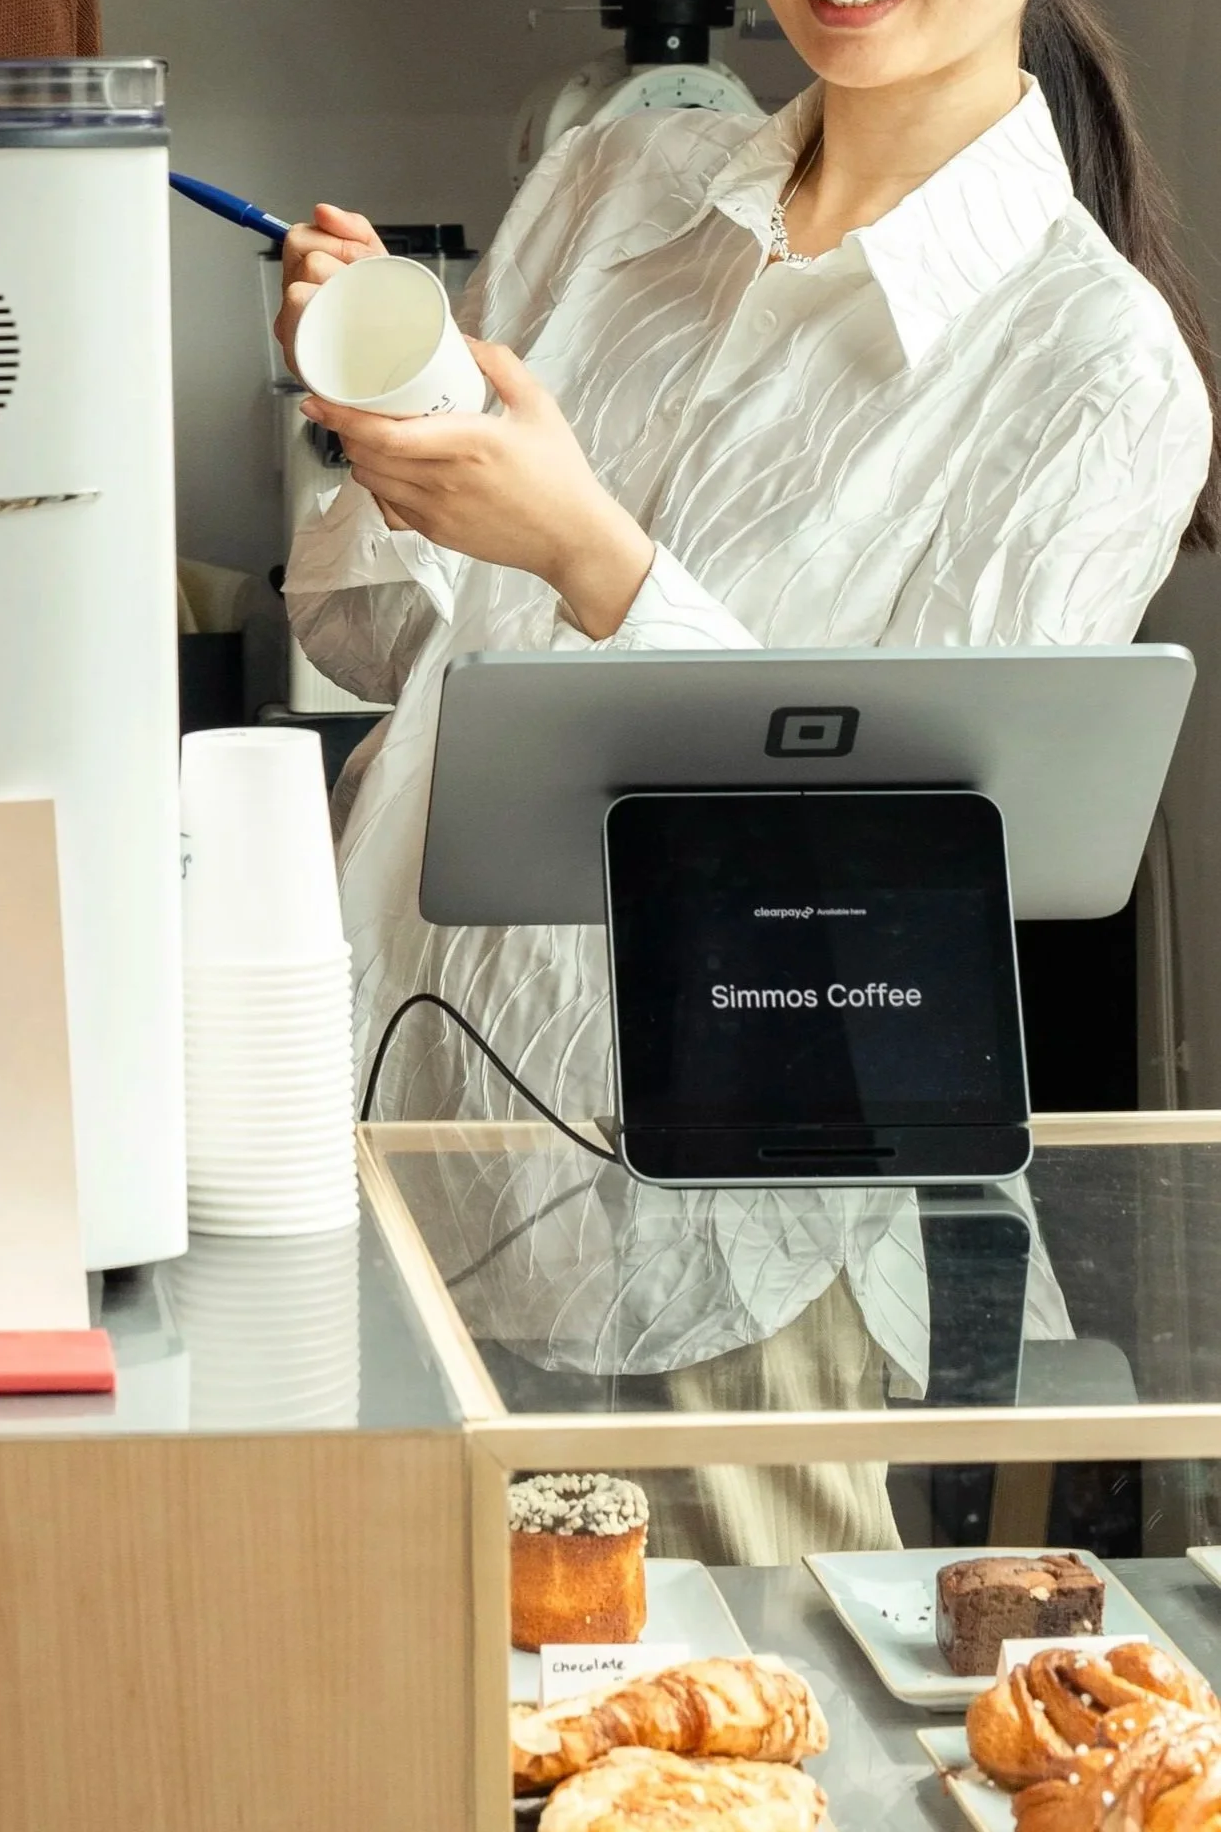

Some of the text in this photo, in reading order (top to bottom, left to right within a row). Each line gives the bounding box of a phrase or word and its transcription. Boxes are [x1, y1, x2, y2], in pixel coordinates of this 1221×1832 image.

[754, 907, 801, 919] clearpay
[711, 982, 922, 1009] Simmos Coffee
[552, 1657, 625, 1674] Chocolate
